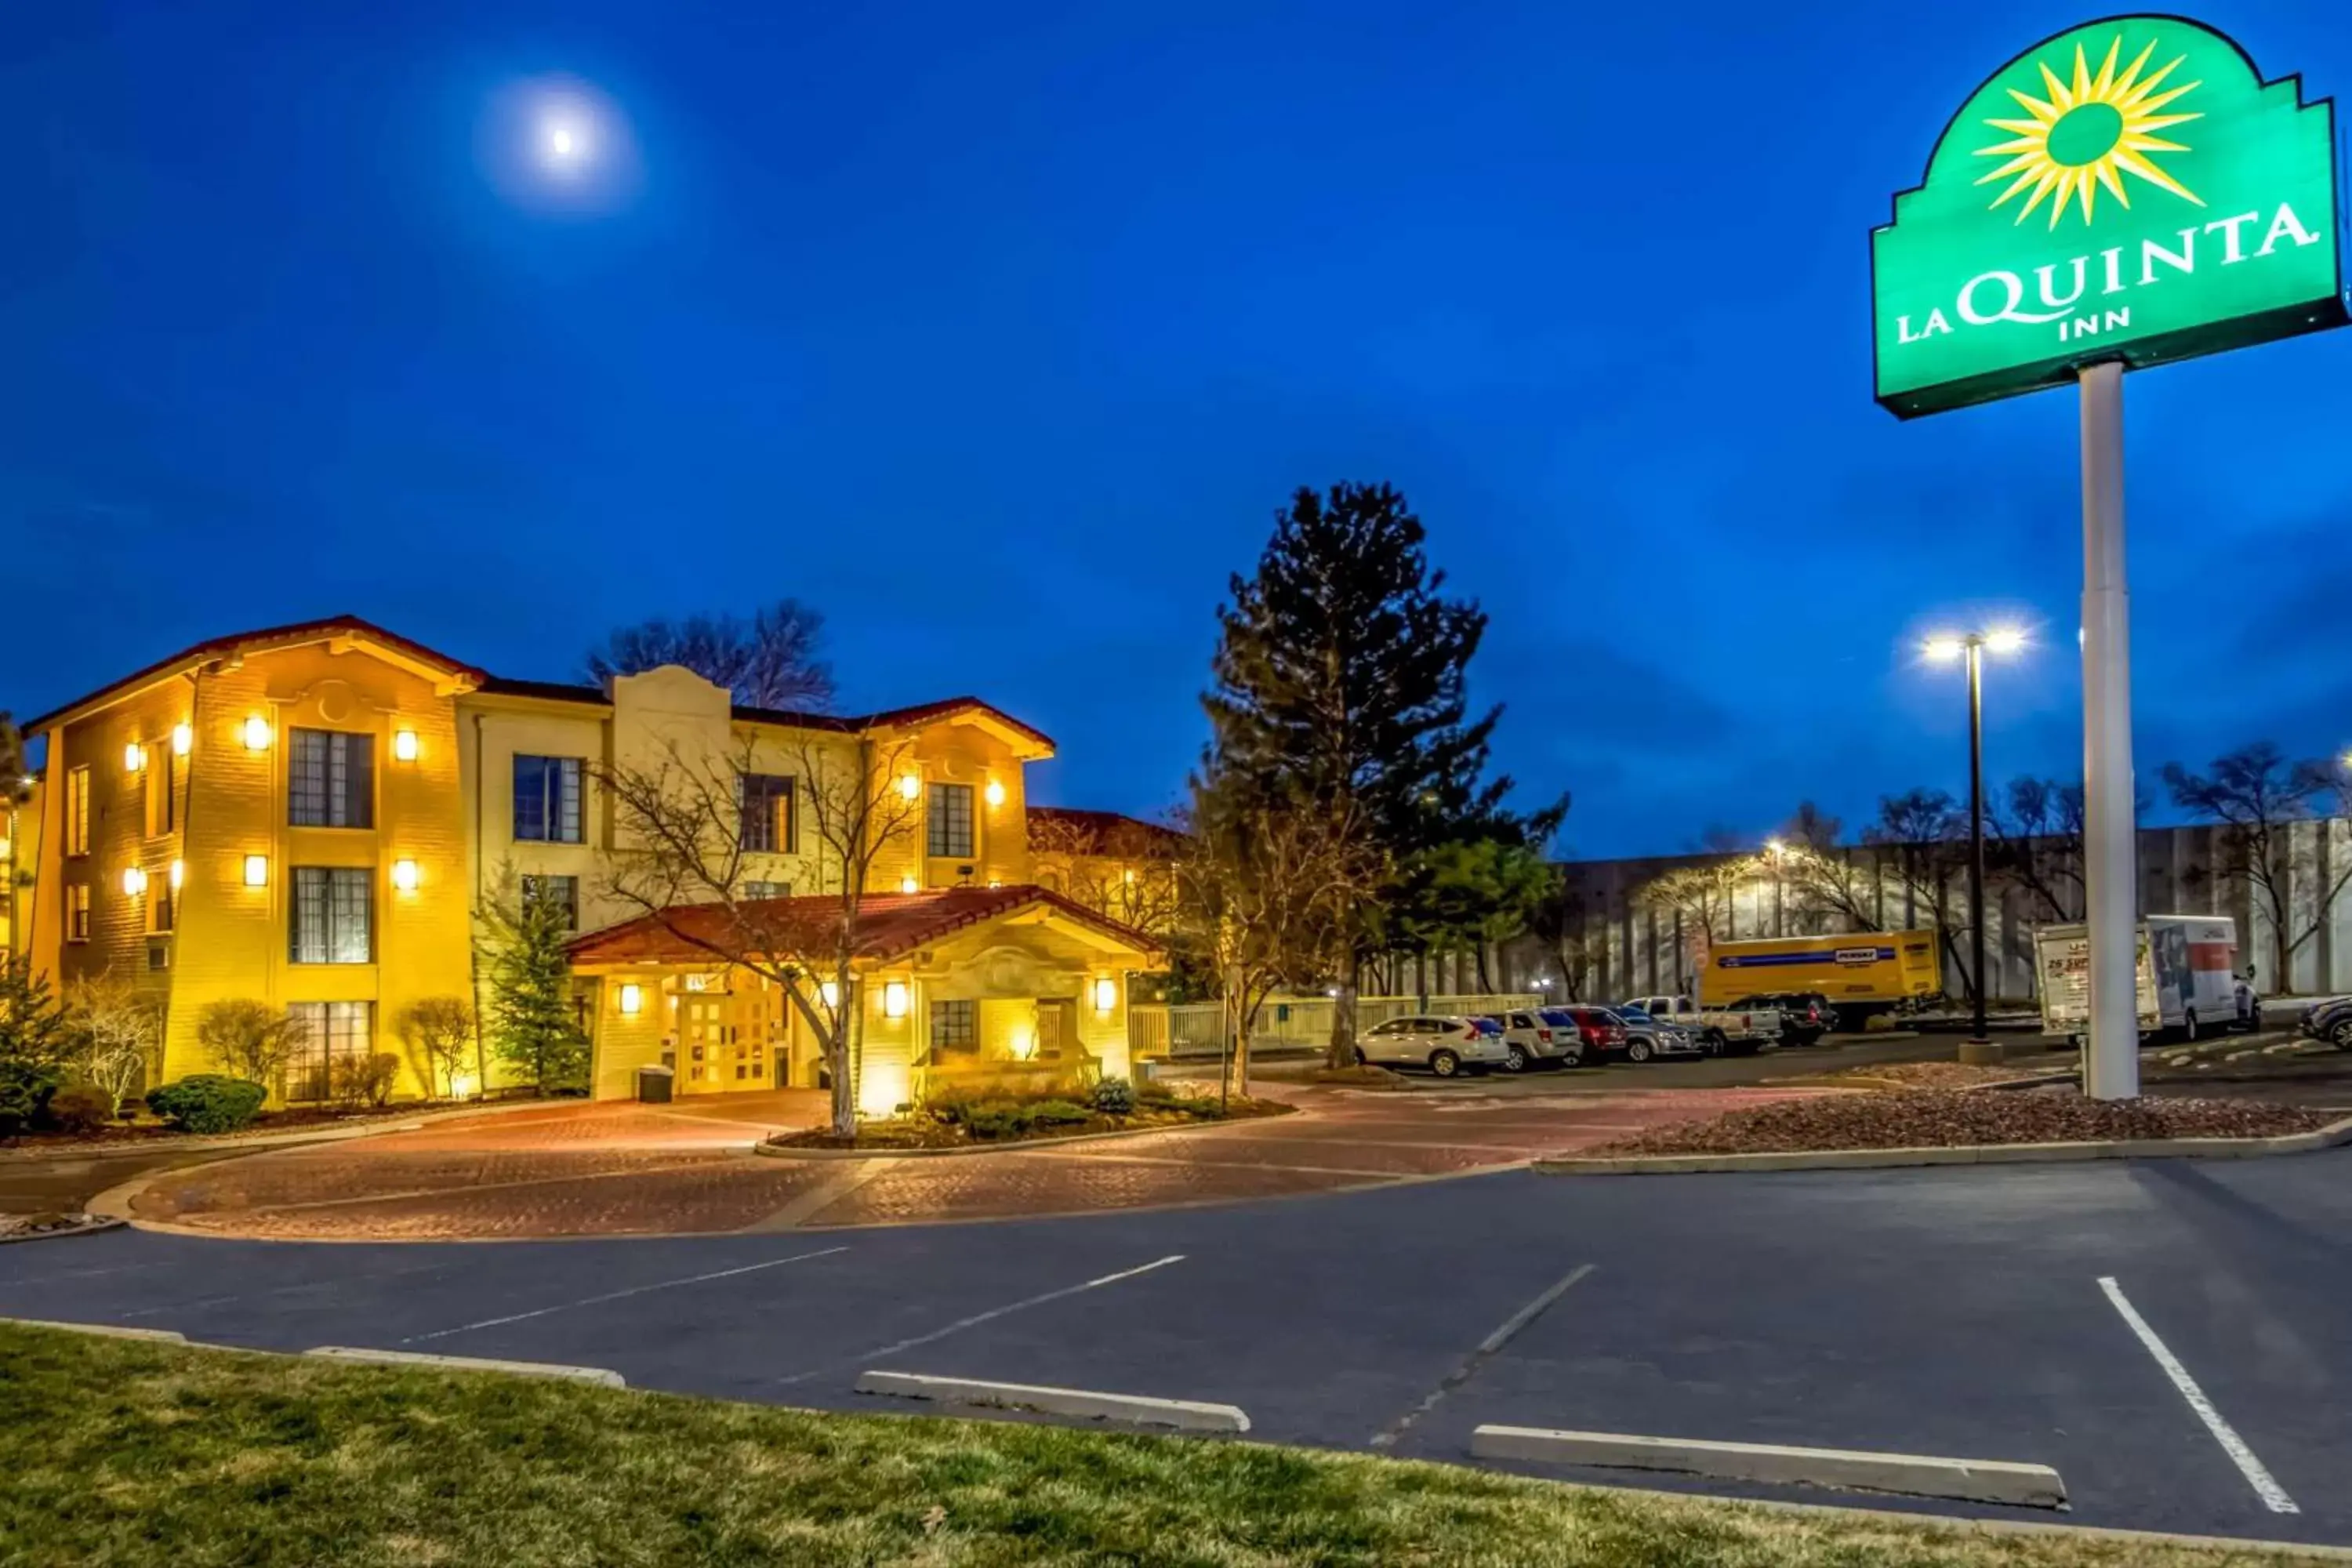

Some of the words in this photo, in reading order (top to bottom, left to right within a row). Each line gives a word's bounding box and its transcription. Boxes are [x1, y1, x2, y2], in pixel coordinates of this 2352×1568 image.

[1896, 308, 1954, 343] LA
[1957, 201, 2320, 325] QUINTA
[2059, 307, 2130, 342] INN
